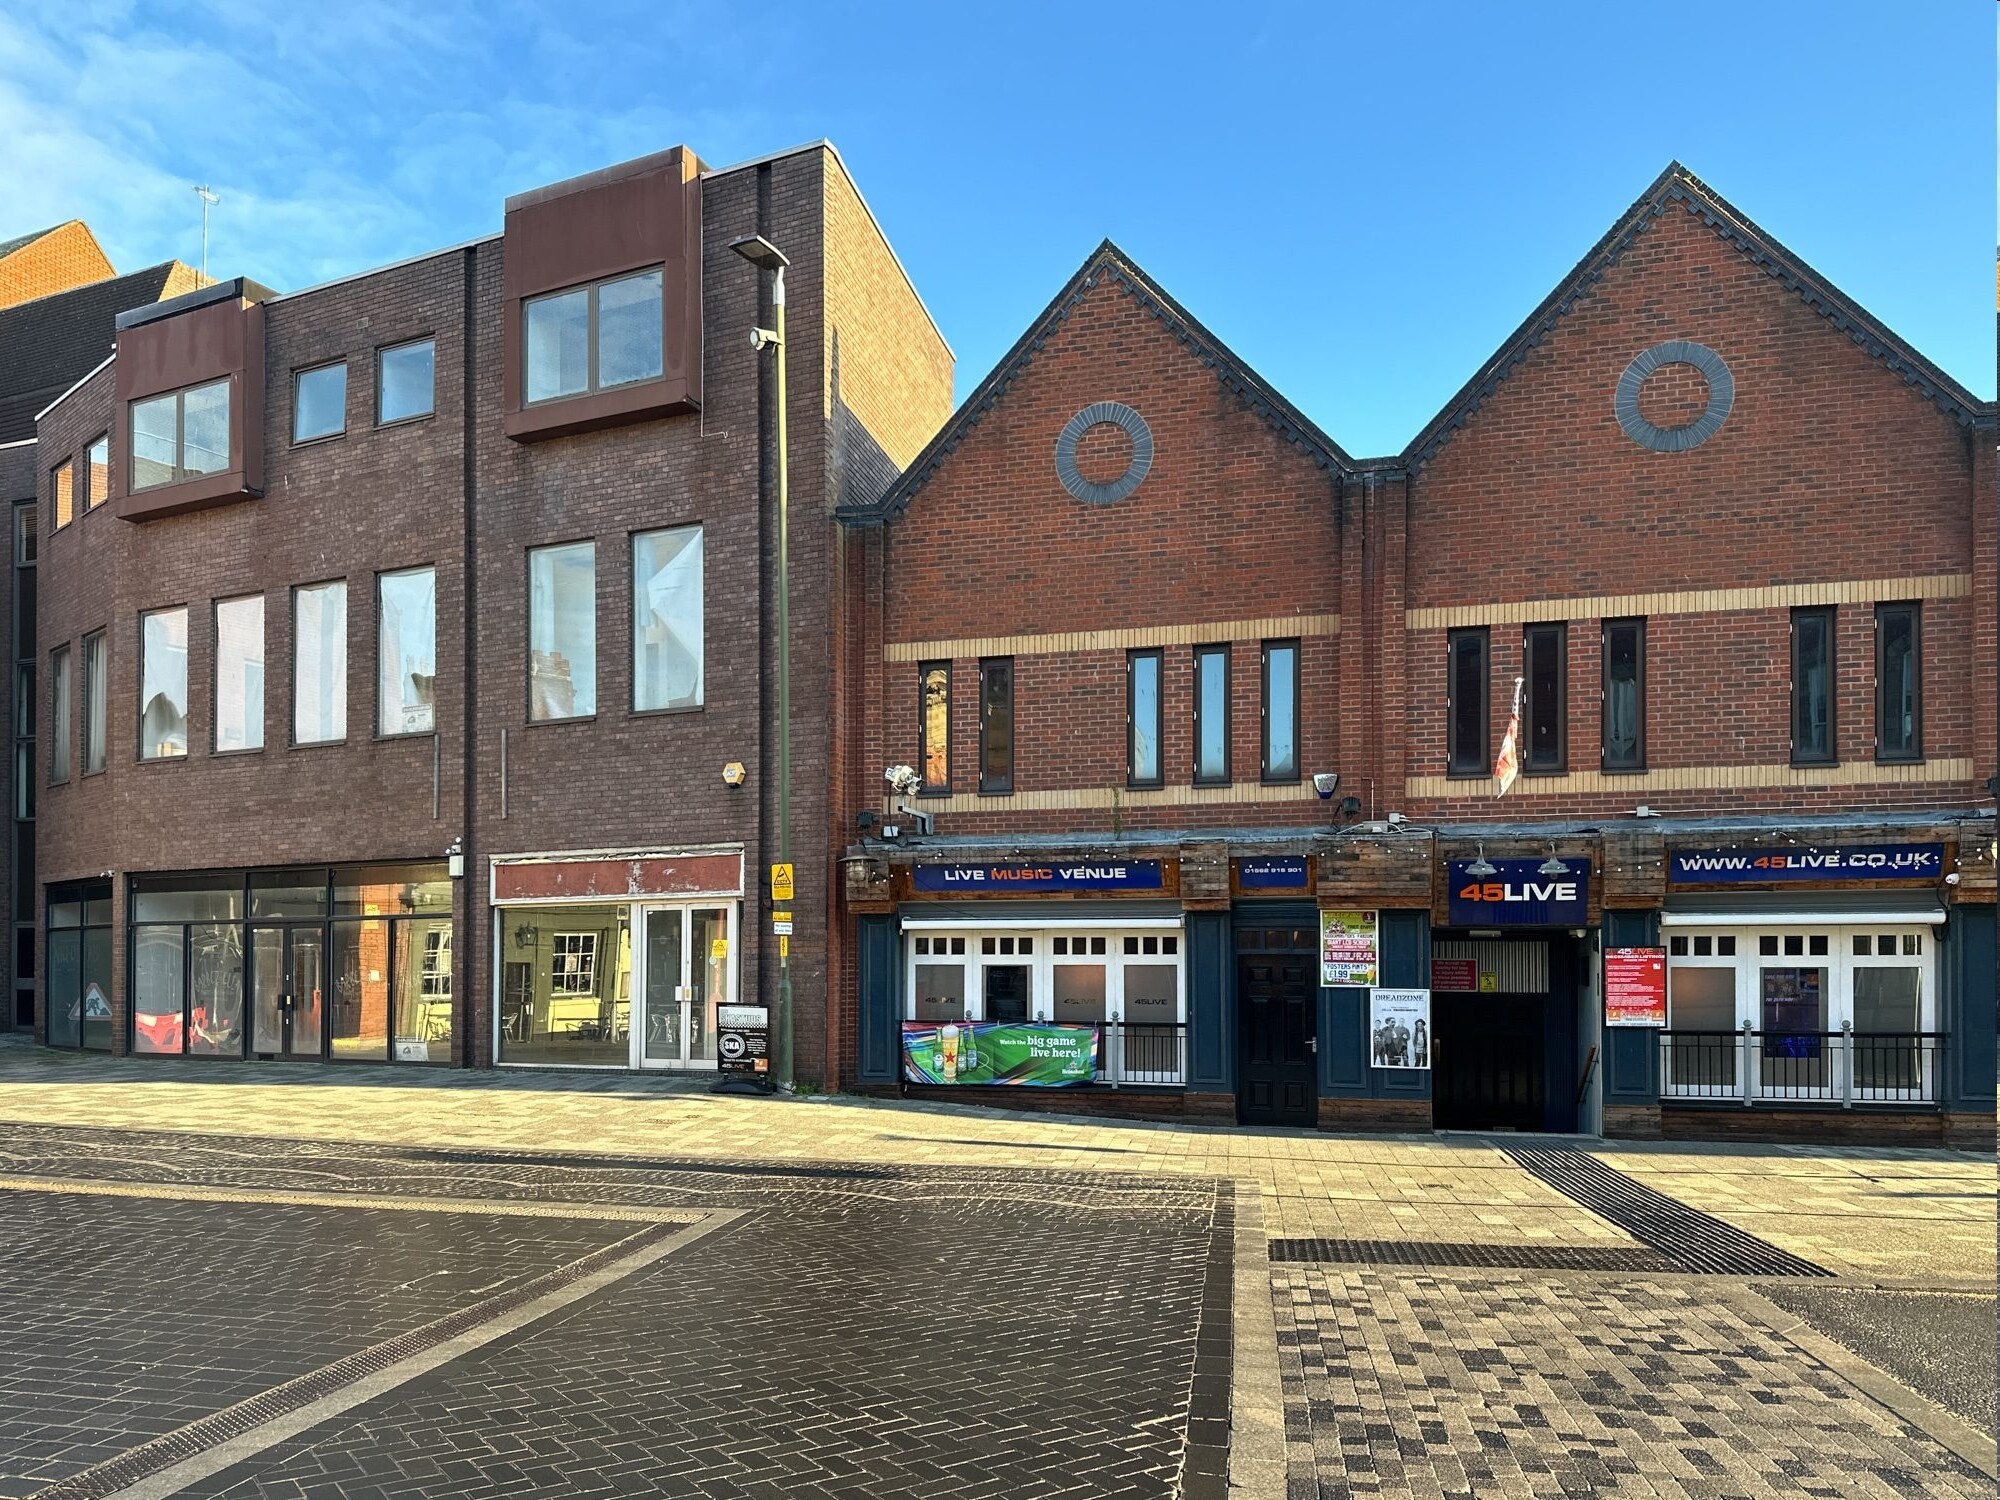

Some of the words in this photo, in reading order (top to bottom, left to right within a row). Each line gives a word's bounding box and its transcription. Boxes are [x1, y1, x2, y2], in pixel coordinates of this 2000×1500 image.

[1680, 852, 1932, 871] WWW.45LIVE.CO.UK
[944, 868, 985, 881] LIVE
[991, 868, 1053, 881] MUSIC
[1059, 867, 1127, 880] VENUE
[1459, 882, 1577, 902] 45LIVE
[1617, 947, 1654, 955] 45LIVE
[1329, 970, 1348, 978] £1.99
[1375, 994, 1424, 1002] DREADZONE
[724, 1041, 740, 1050] SKA
[1027, 1035, 1044, 1048] big
[1046, 1037, 1076, 1048] game
[1030, 1047, 1050, 1058] live
[1052, 1047, 1081, 1058] here!
